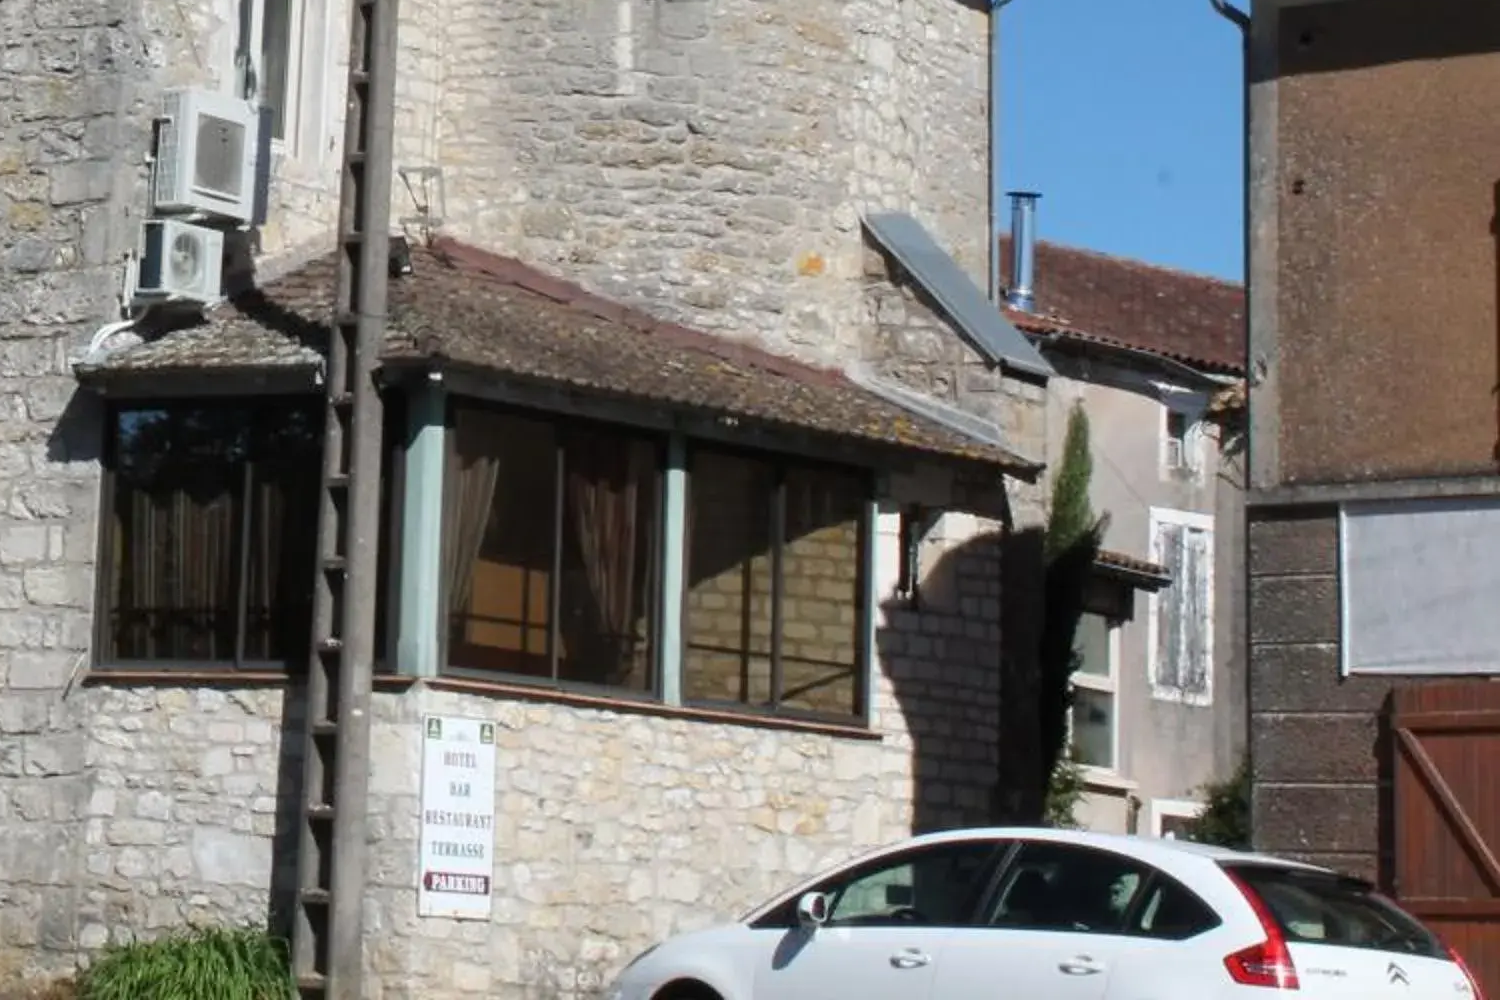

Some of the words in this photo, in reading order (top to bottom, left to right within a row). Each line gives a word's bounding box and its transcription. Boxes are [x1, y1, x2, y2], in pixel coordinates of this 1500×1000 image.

[449, 781, 471, 797] BAR
[425, 809, 492, 830] RESTAURANT
[431, 840, 485, 859] TERRASSE
[432, 873, 484, 892] PARKING
